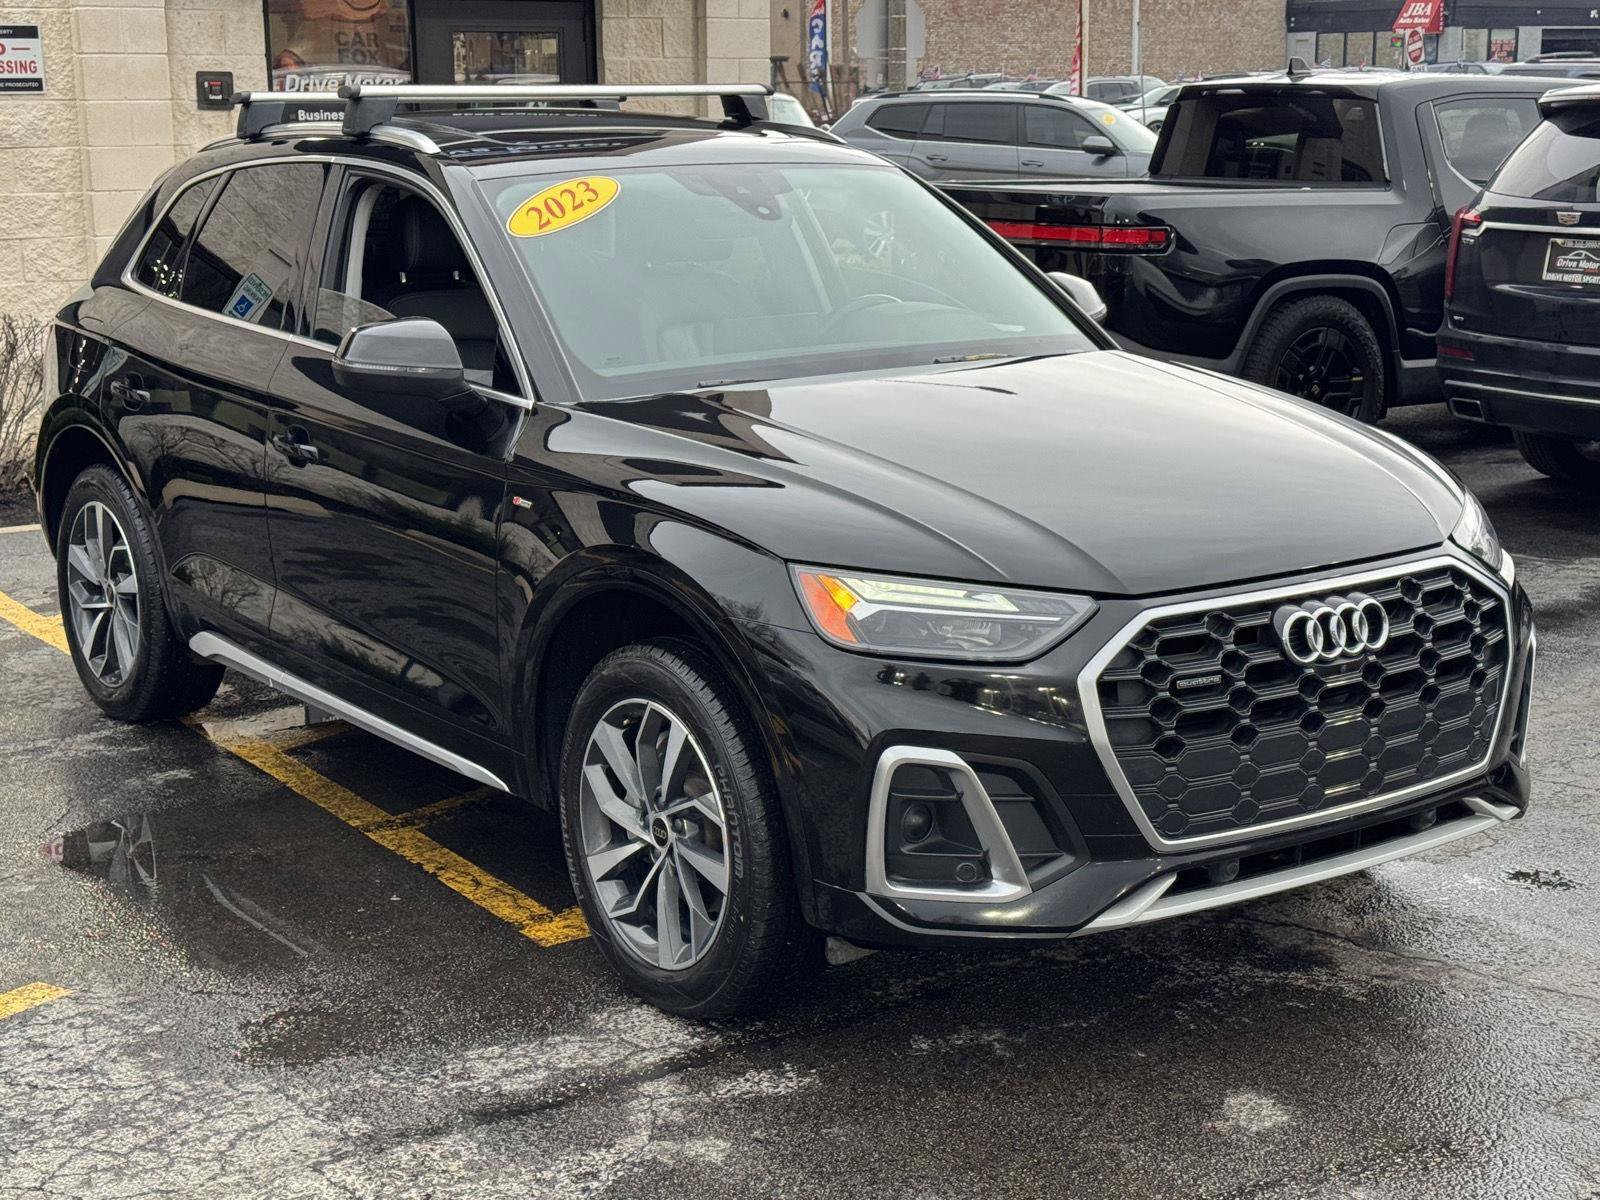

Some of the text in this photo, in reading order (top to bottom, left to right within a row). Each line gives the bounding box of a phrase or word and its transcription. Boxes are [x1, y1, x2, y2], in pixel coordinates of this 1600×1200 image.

[1403, 2, 1433, 17] JBA
[335, 31, 379, 47] CAR
[337, 48, 379, 64] FOX
[0, 60, 38, 74] SSING
[285, 74, 339, 92] Drive
[297, 109, 345, 121] Busines
[526, 181, 599, 230] 2023
[1557, 258, 1600, 269] Drive Motor
[1563, 273, 1583, 283] MOTOR
[1179, 677, 1220, 687] quattro
